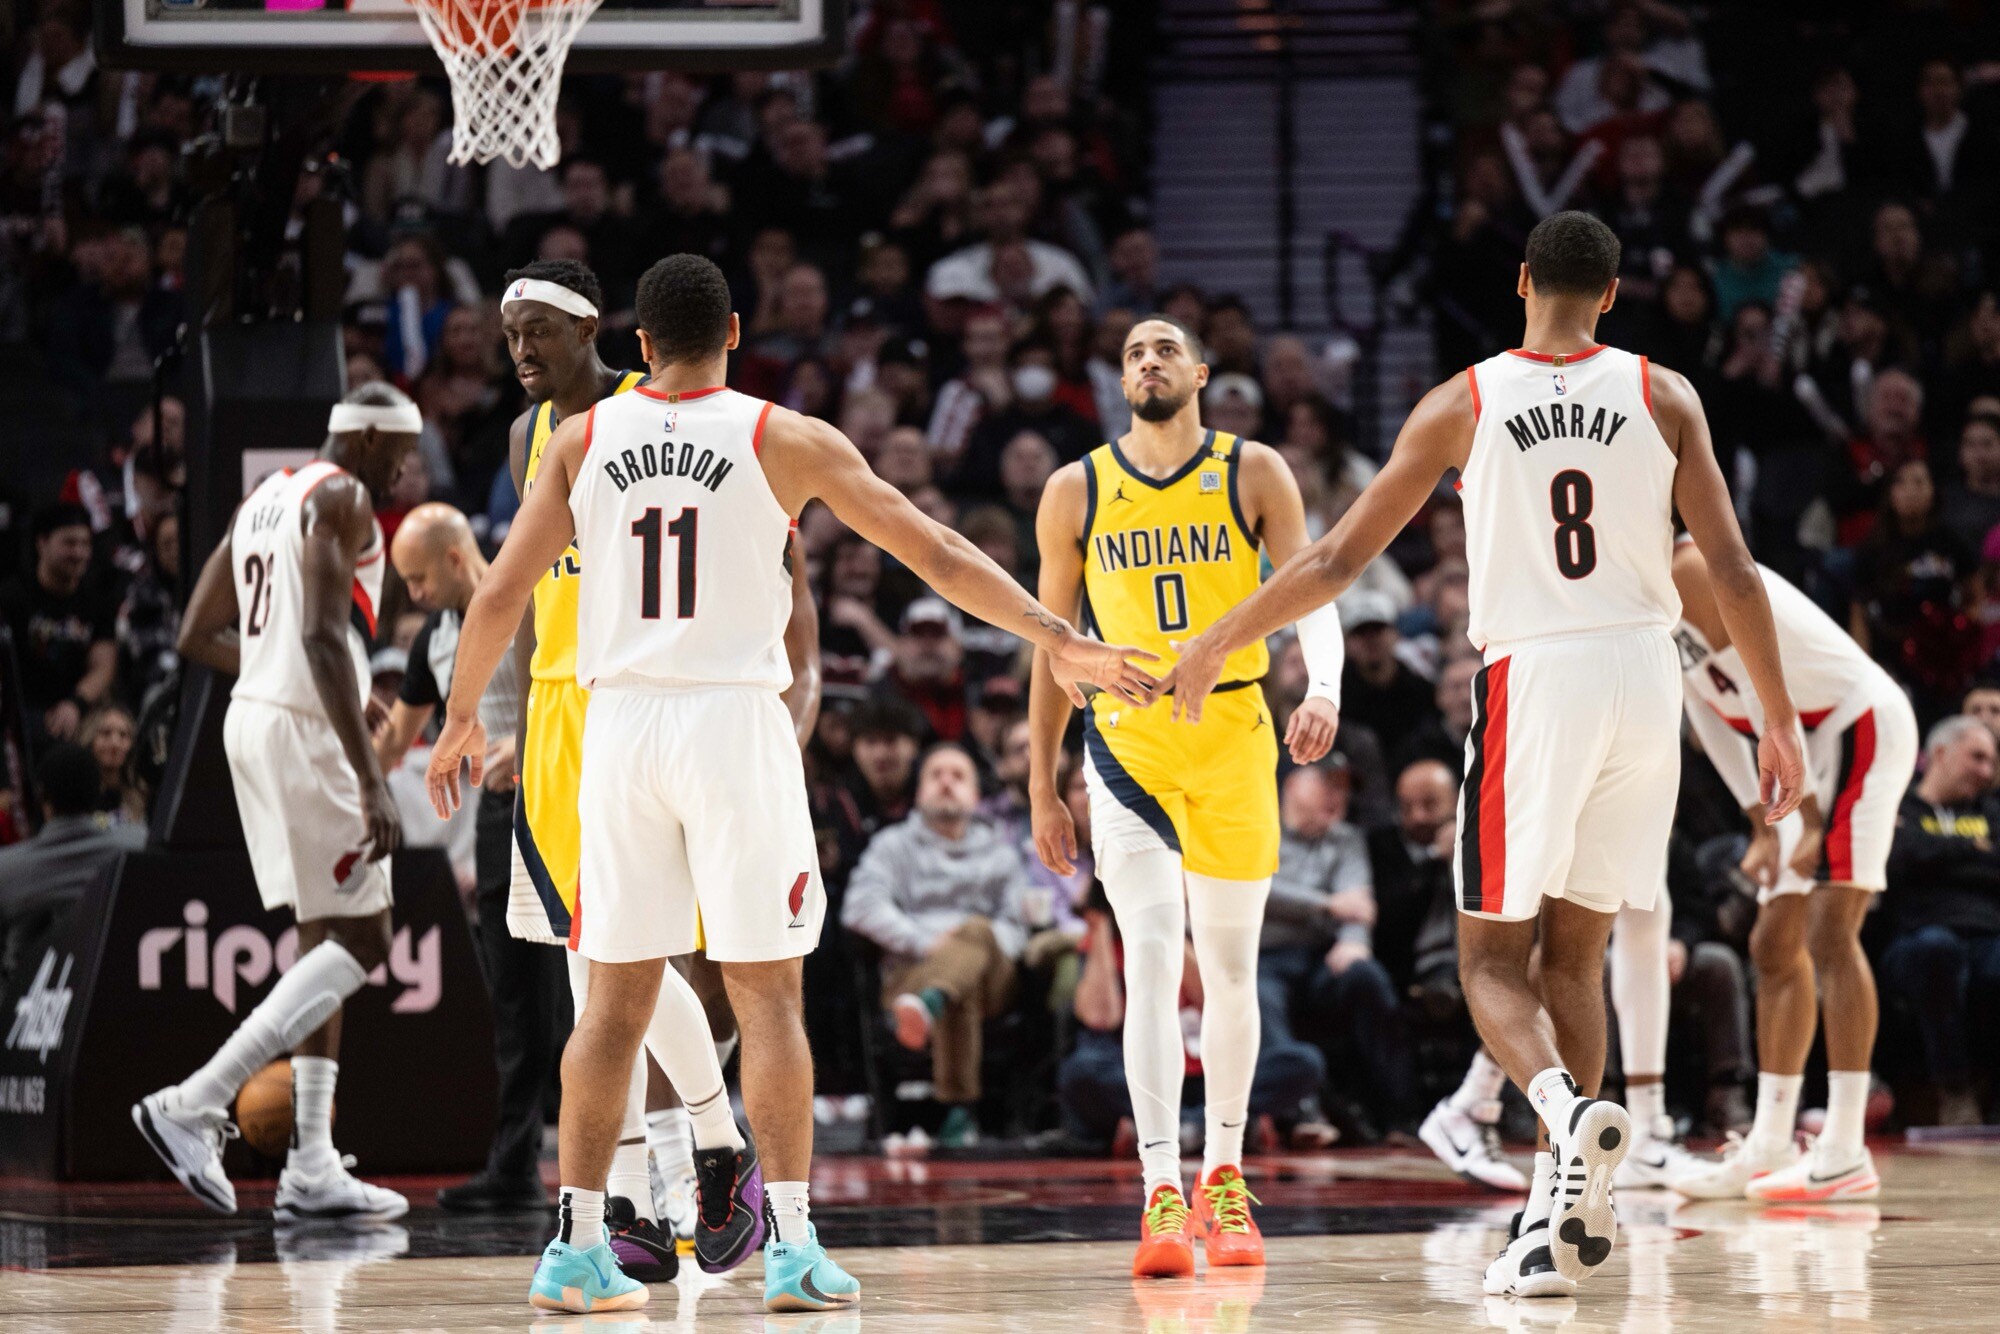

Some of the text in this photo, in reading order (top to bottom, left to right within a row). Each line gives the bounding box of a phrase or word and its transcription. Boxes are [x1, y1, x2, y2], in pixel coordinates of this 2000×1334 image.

[1504, 403, 1627, 452] MURRAY
[604, 442, 734, 492] BROGDON
[1095, 524, 1231, 573] INDIANA
[1550, 468, 1597, 580] 8
[631, 507, 698, 619] 11
[1154, 572, 1189, 632] 0
